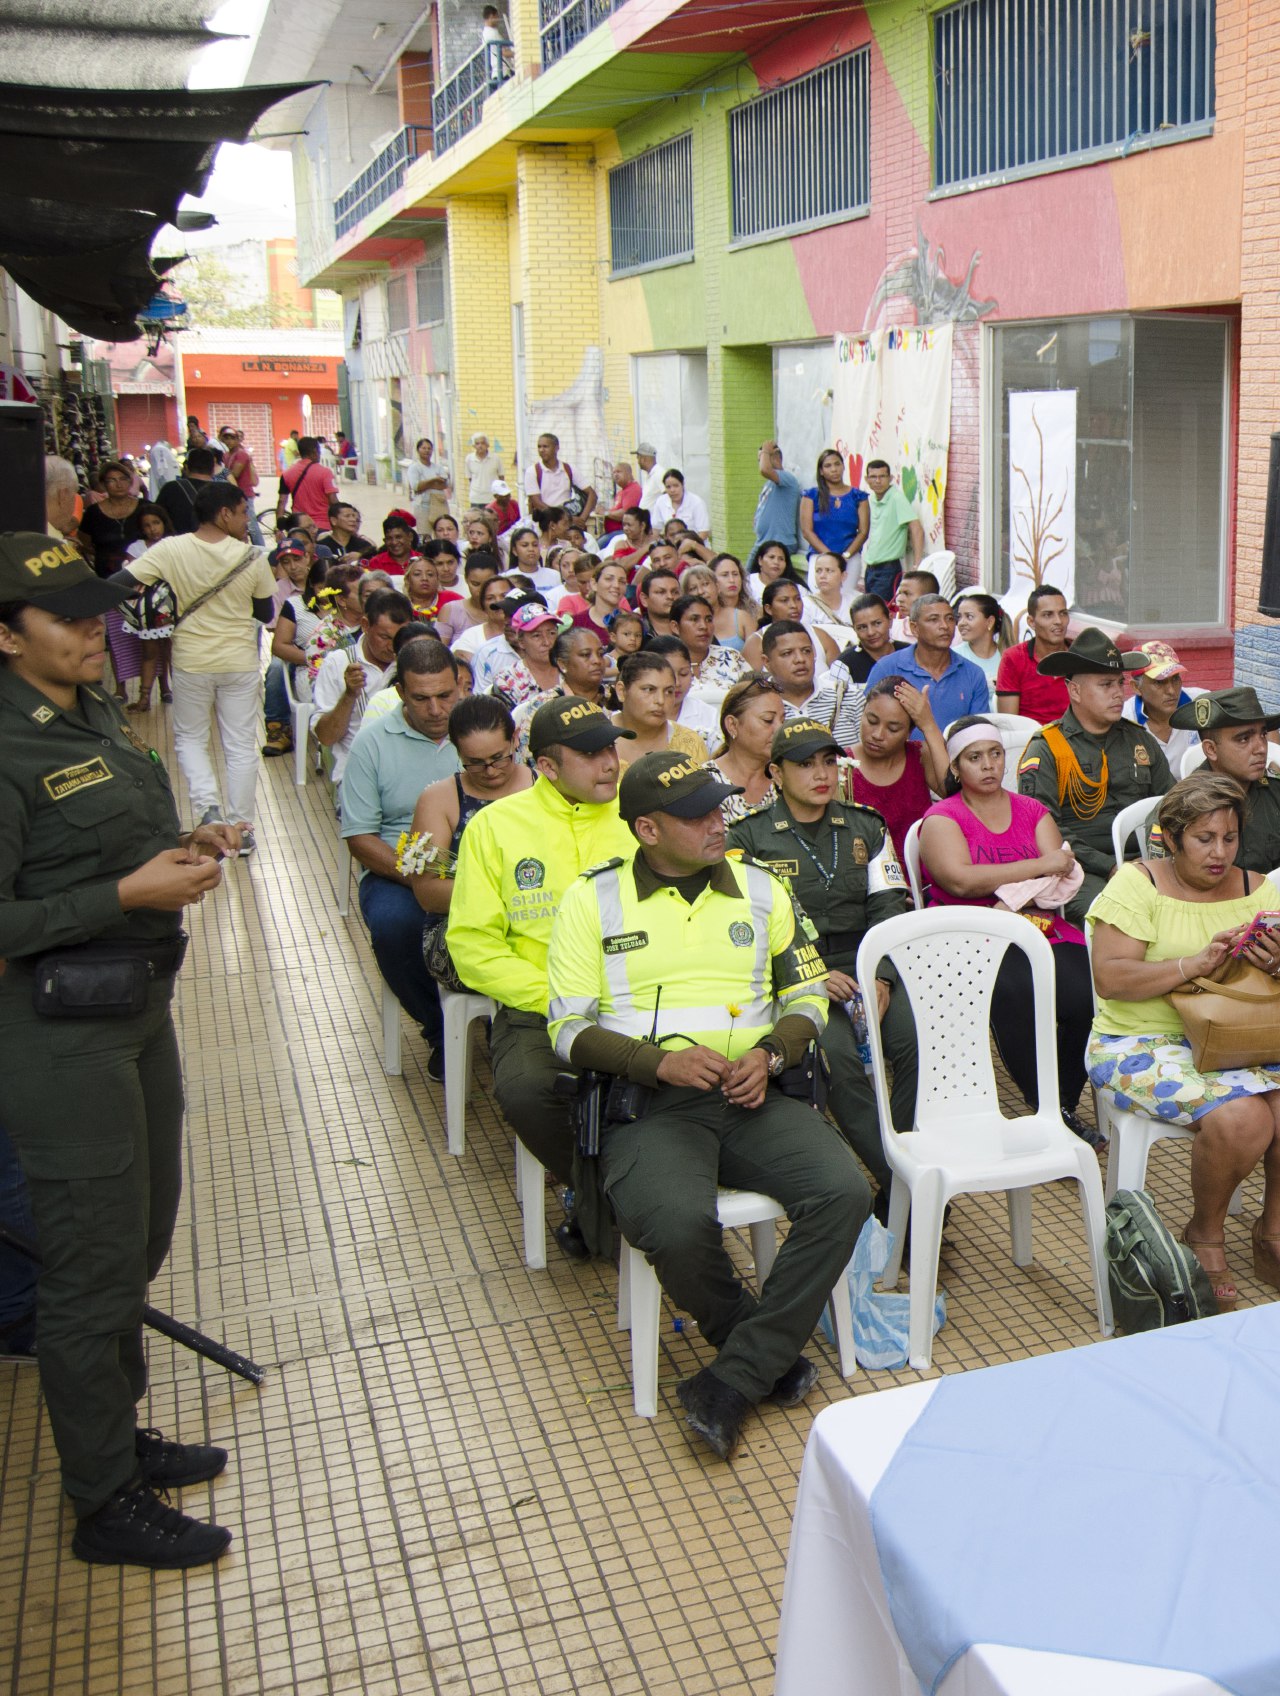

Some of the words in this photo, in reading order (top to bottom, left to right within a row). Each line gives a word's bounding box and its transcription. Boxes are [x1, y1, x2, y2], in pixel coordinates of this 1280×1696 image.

[275, 362, 325, 373] BONANZA
[976, 844, 1039, 864] NEW
[511, 891, 553, 907] SIJIN
